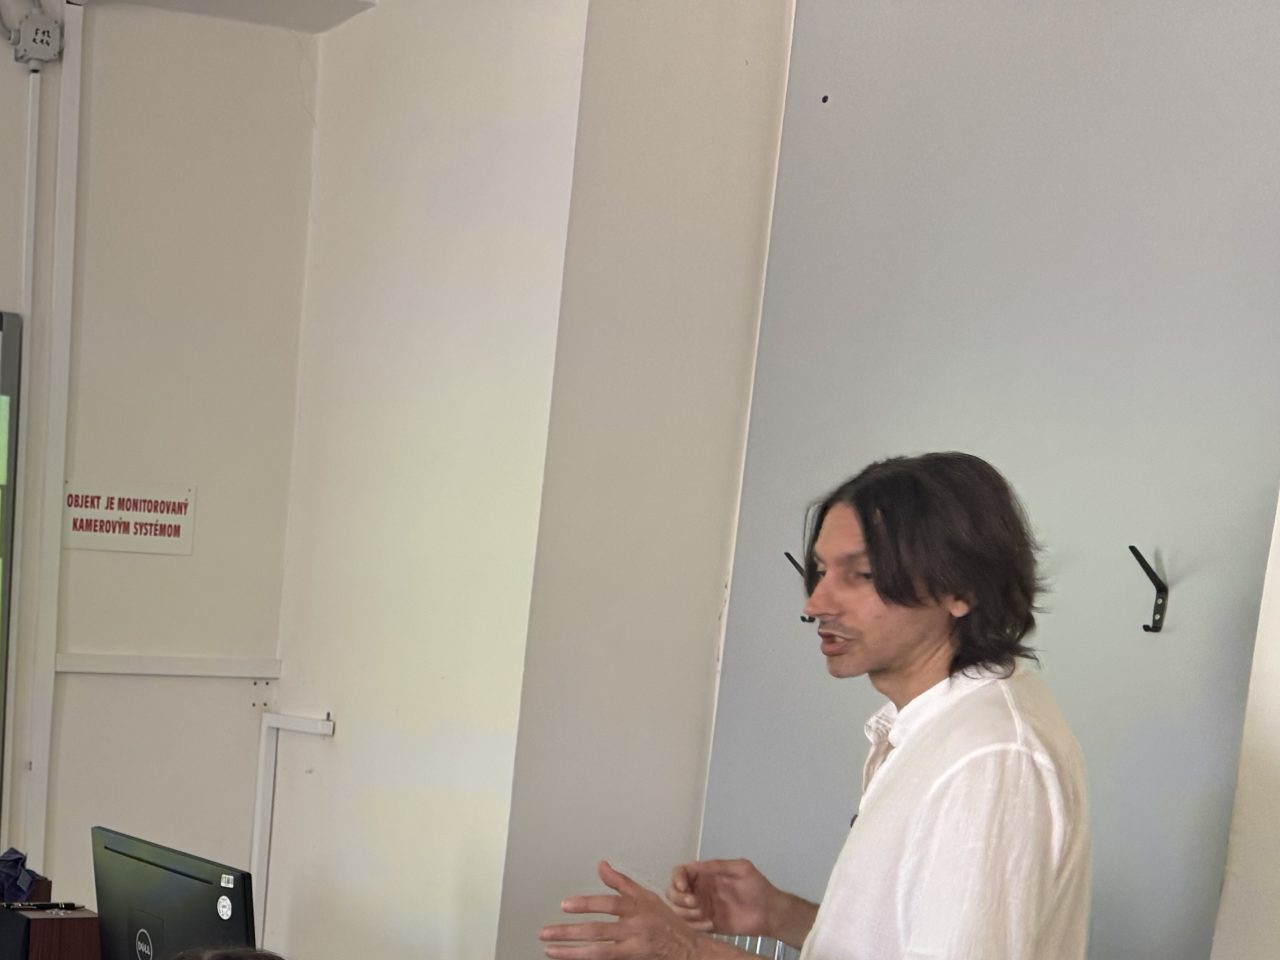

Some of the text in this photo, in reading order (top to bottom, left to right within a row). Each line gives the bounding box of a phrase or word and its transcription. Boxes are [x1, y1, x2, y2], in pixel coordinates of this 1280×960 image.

[66, 493, 190, 516] OBJEKT JE MONITOROVANÝ
[71, 516, 181, 538] KAMEROVÝM SYSTÉMOM
[138, 941, 151, 955] DELL
